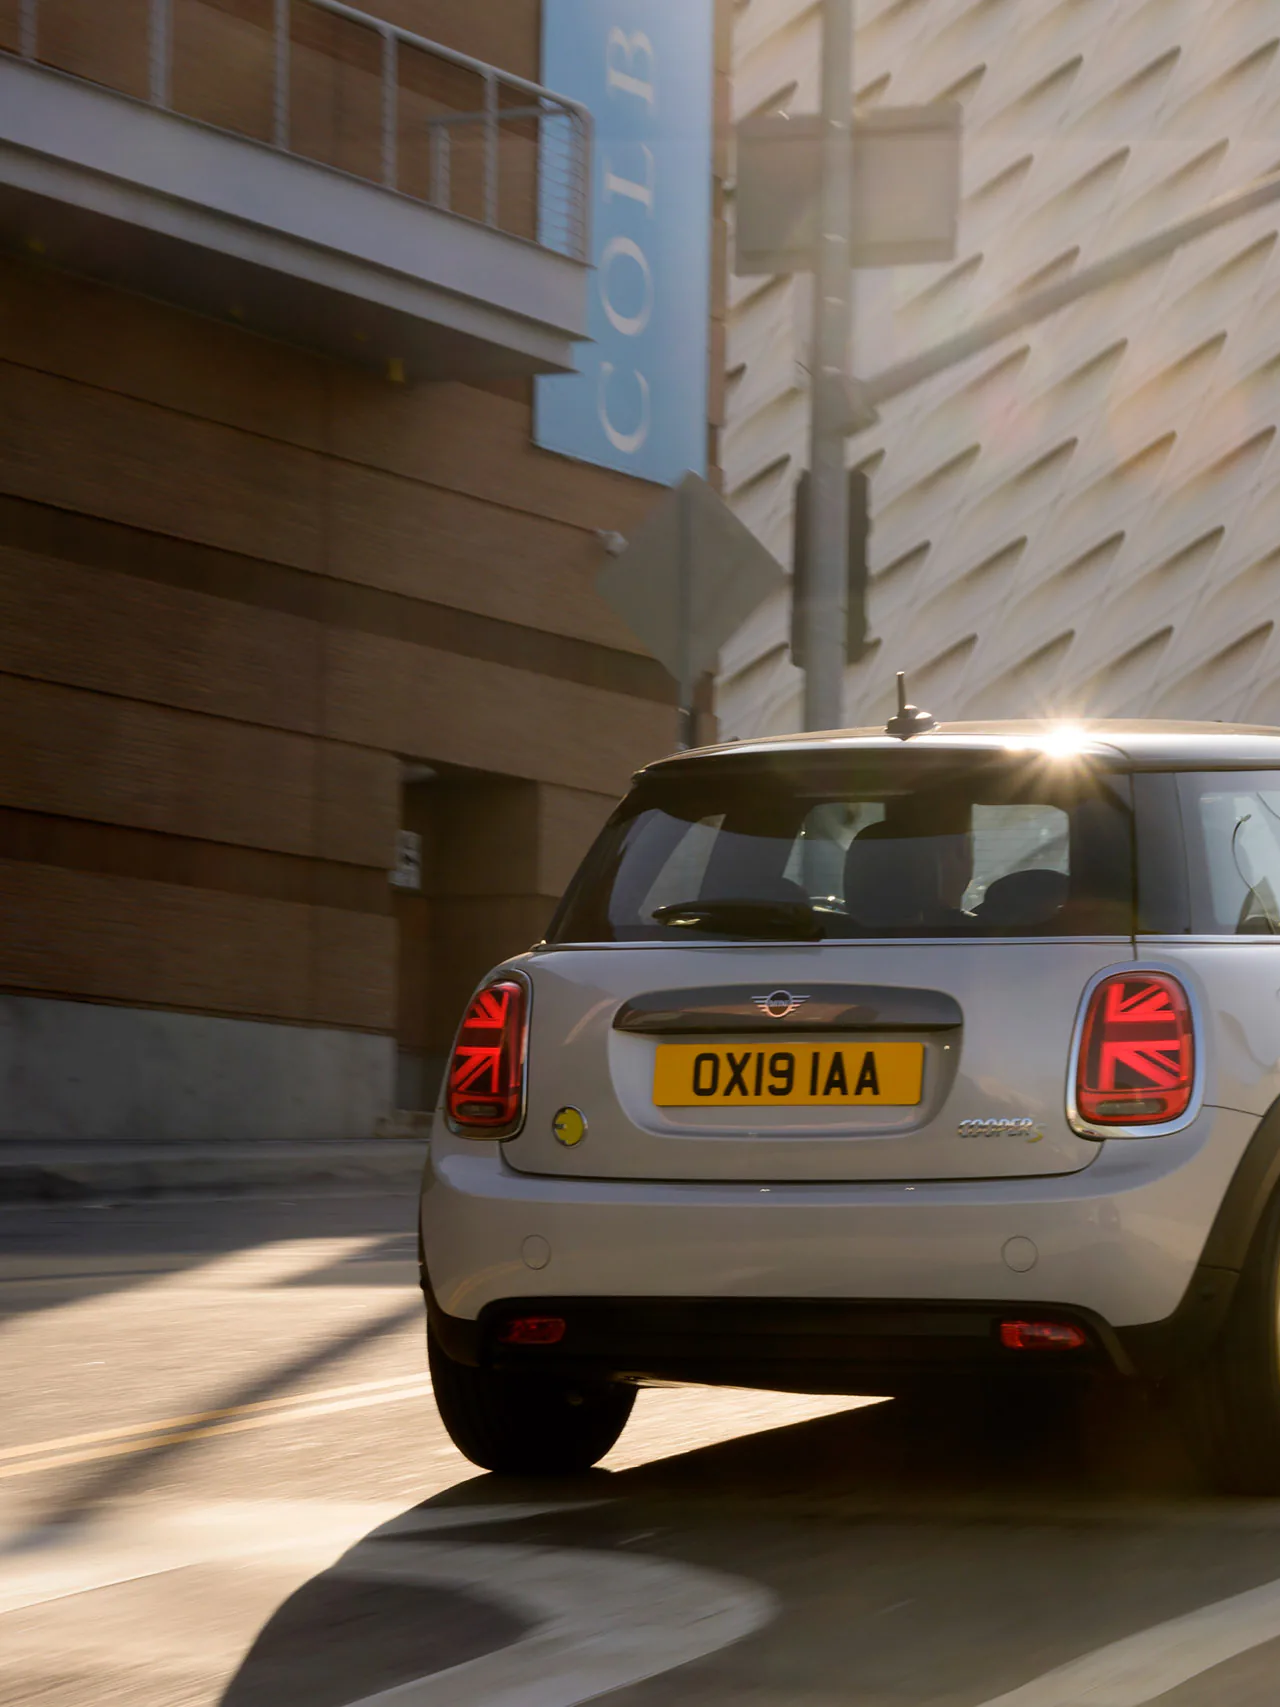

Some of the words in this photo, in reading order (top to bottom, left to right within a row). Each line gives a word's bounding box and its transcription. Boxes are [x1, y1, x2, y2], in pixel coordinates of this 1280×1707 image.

[599, 25, 655, 456] COLB
[692, 1052, 795, 1097] OX19
[958, 1117, 1033, 1138] COOPER
